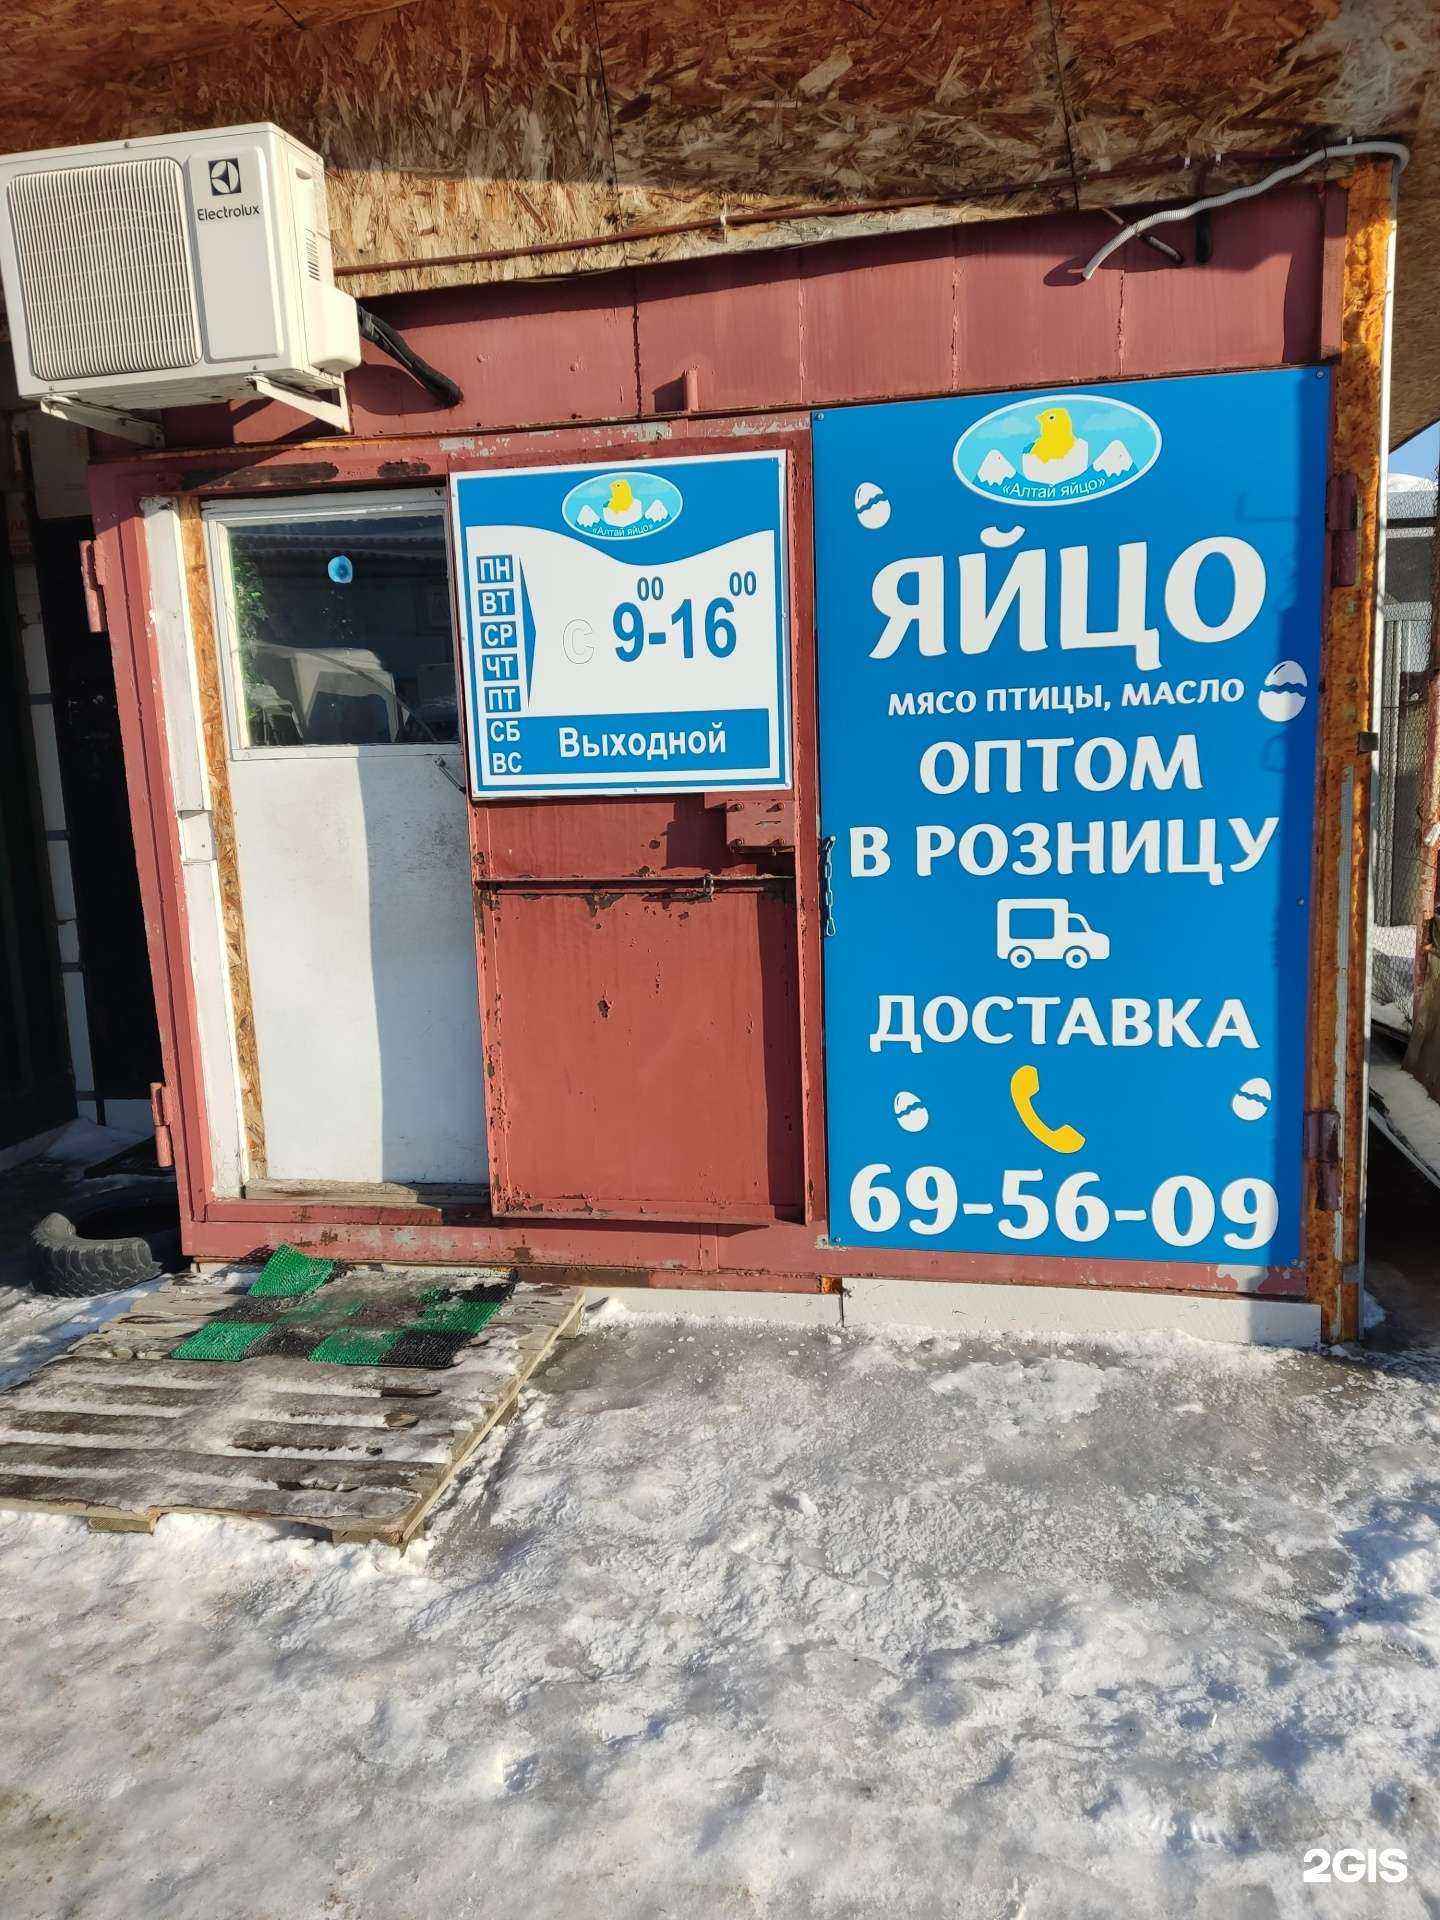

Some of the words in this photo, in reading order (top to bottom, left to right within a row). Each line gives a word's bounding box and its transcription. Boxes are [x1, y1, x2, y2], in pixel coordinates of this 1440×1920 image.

[197, 203, 260, 221] Electrolux
[1002, 482, 1056, 499] «Алтай
[1060, 477, 1106, 497] яйцо»
[480, 558, 511, 581] ПН
[481, 591, 510, 613] ВТ
[868, 524, 1267, 672] ЯЙЦО
[484, 624, 513, 647] СР
[486, 657, 514, 678] ЧТ
[488, 689, 516, 711] ПТ
[888, 688, 977, 717] МЯСО
[986, 684, 1112, 714] ПТИЦЫ,
[1121, 677, 1245, 707] МАСЛО
[490, 721, 521, 742] СБ
[558, 722, 726, 760] Выходной
[493, 753, 523, 774] ВС
[919, 734, 1203, 795] ОПТОМ
[849, 826, 892, 878] В
[915, 816, 1280, 886] РОЗНИЦУ
[869, 994, 1261, 1054] ДОСТАВКА
[850, 1163, 1279, 1250] 69-56-09
